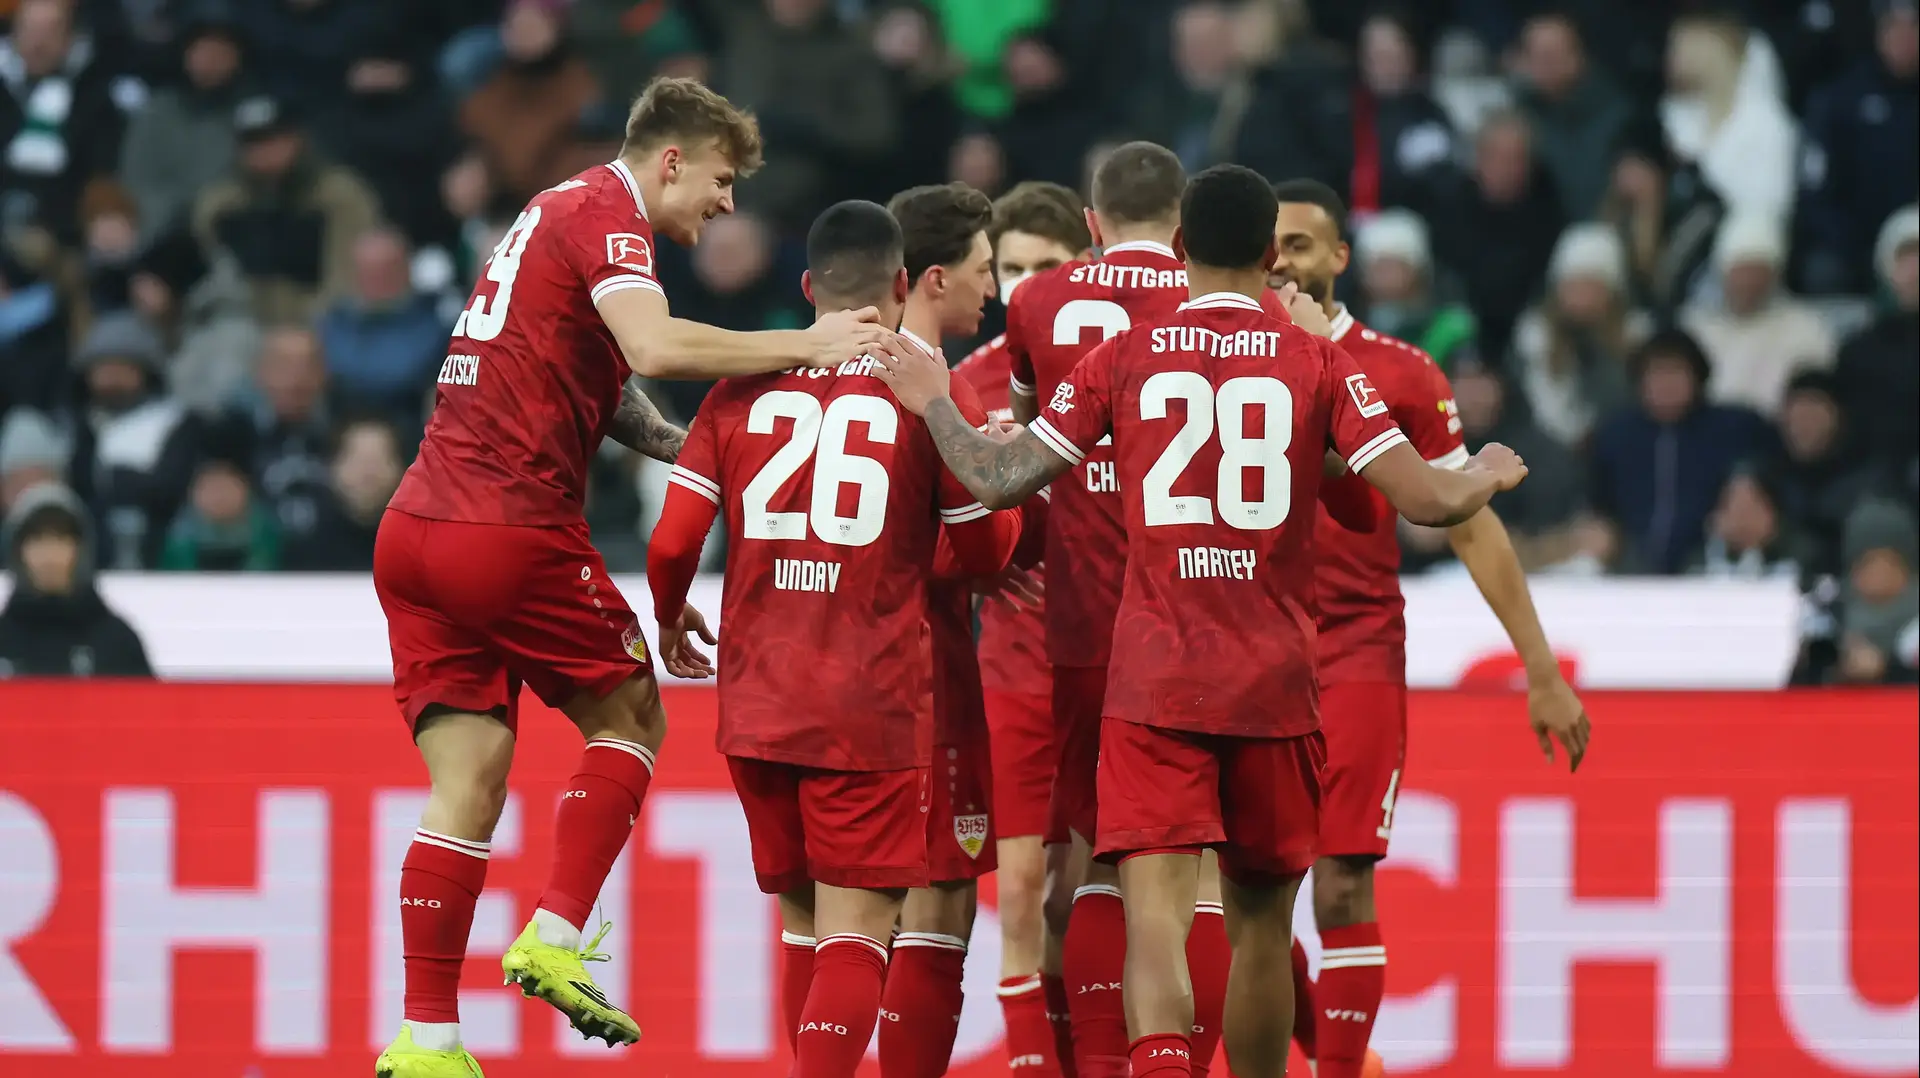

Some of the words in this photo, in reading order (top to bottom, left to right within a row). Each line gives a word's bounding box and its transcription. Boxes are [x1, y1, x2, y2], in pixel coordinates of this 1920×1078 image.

[451, 205, 543, 342] 9
[1068, 262, 1189, 289] STUTTGAR
[1151, 326, 1281, 359] STUTTGART
[1139, 371, 1293, 530] 28
[741, 390, 899, 547] 26
[1086, 461, 1121, 492] CH
[774, 558, 842, 593] UNDAV
[1177, 546, 1257, 580] NARTEY
[563, 789, 587, 800] KO
[400, 896, 442, 909] AKO
[1077, 982, 1122, 995] JAK
[797, 1021, 849, 1036] JAKO
